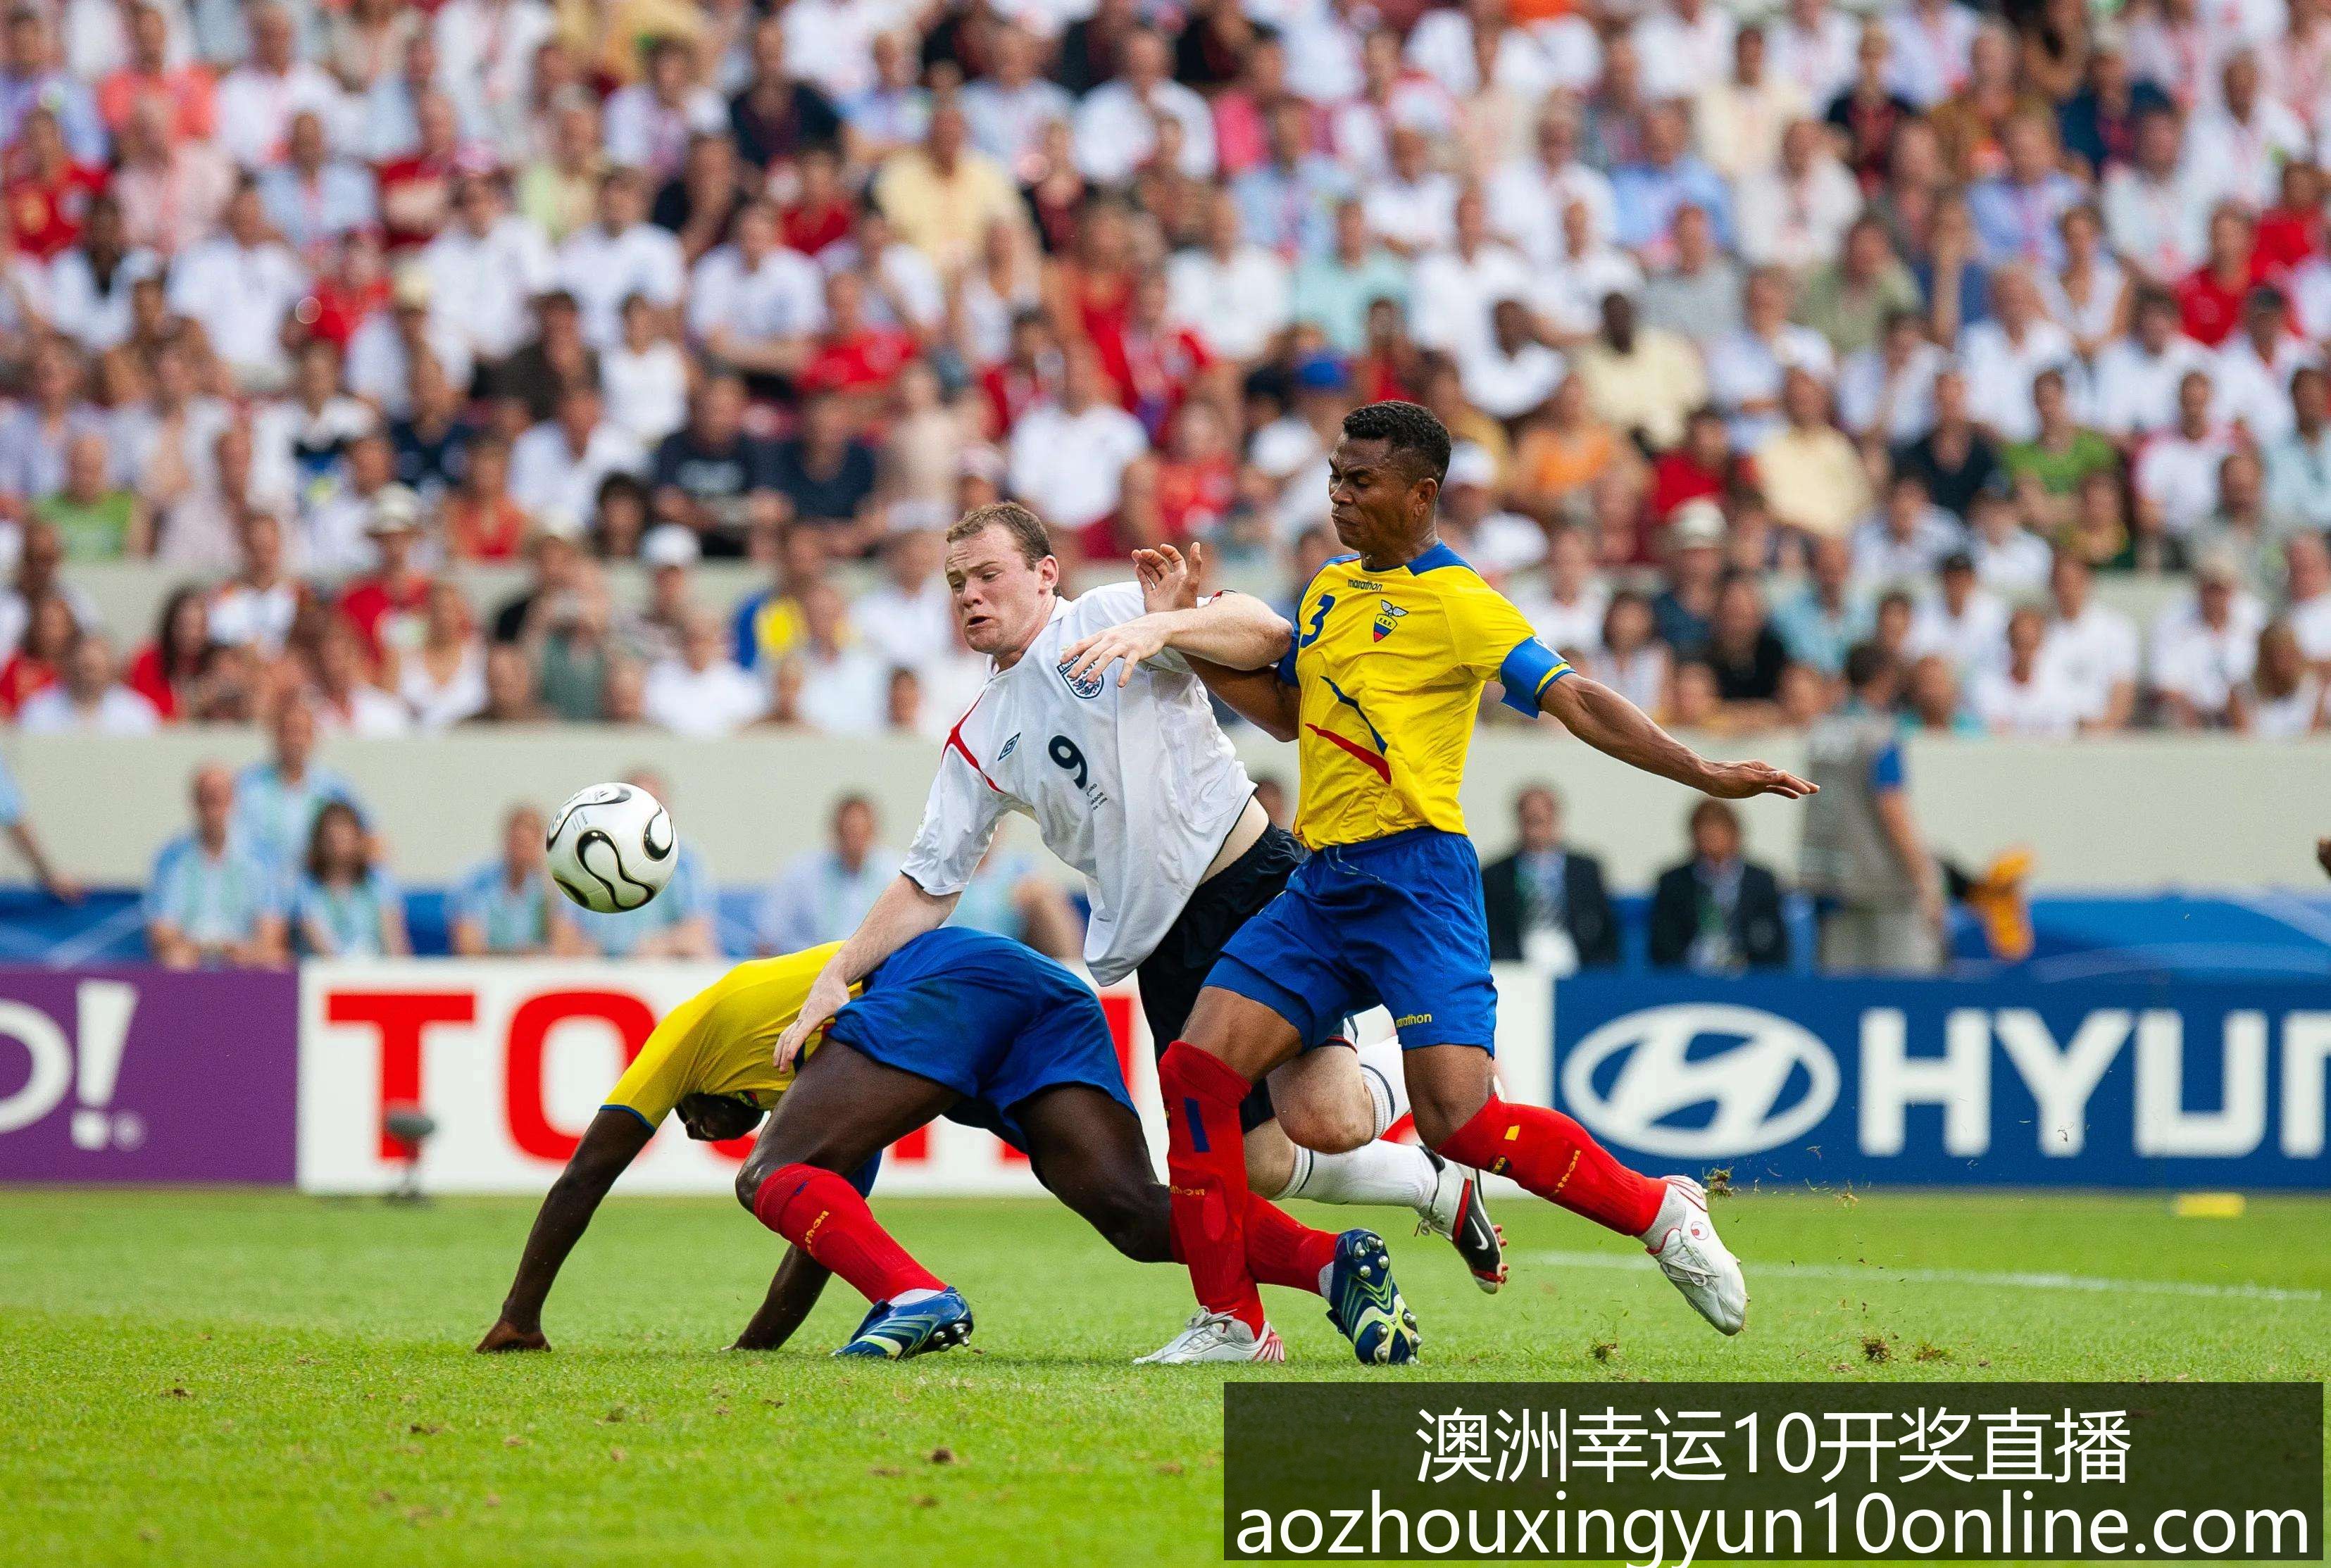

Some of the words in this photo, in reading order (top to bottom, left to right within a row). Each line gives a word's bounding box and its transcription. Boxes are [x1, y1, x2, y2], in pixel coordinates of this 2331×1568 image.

[1347, 578, 1383, 592] marathon
[1300, 594, 1337, 648] 3
[1047, 734, 1088, 789] 9
